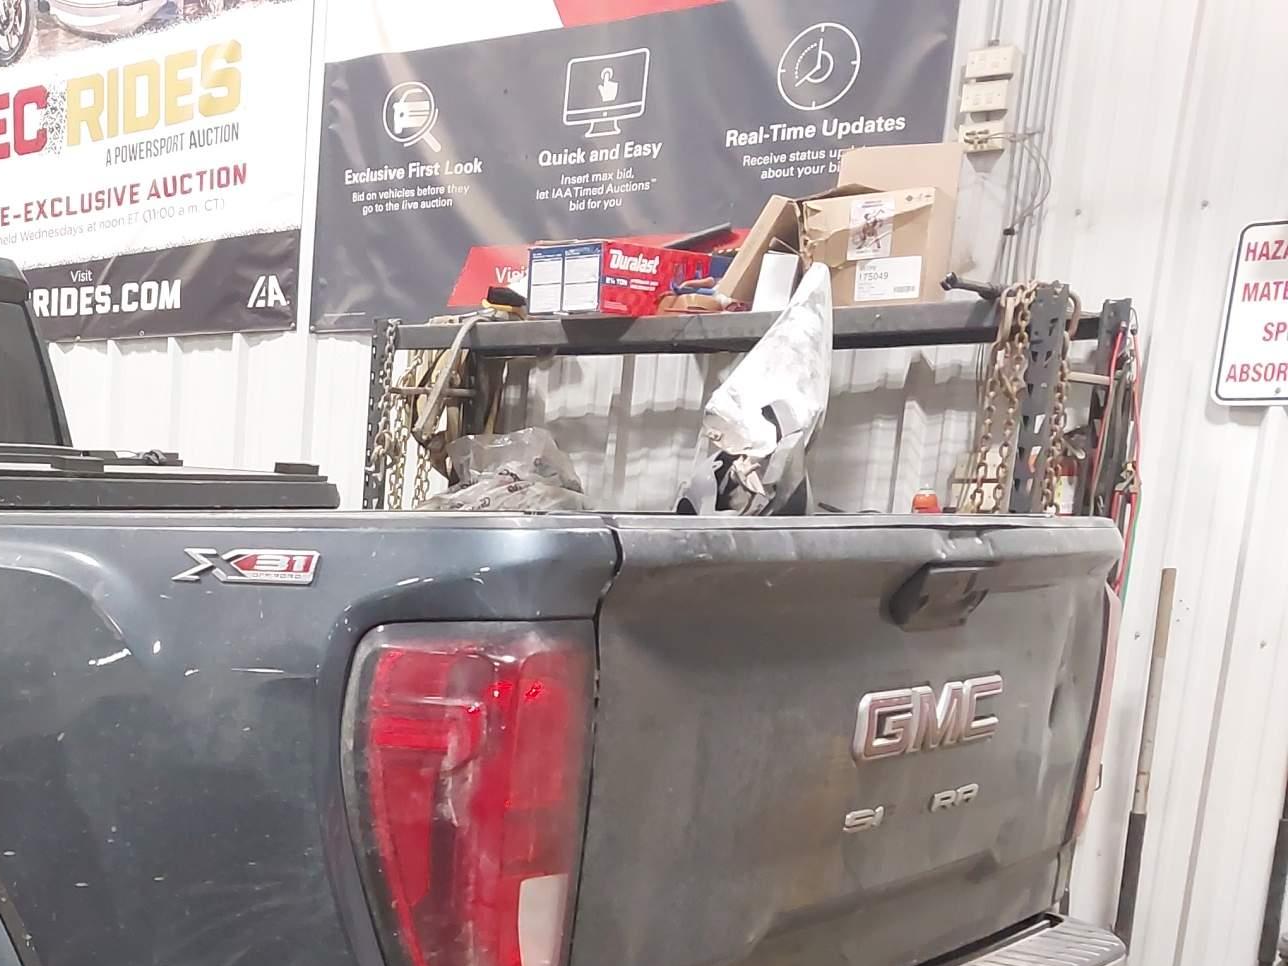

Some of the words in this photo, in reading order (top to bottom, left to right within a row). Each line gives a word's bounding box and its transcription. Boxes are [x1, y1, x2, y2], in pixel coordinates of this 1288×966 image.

[66, 39, 243, 147] RIDES
[105, 148, 112, 167] A
[115, 132, 185, 164] POWERSPORT
[189, 122, 240, 150] AUCTION
[725, 123, 816, 148] Real-Time
[822, 115, 906, 139] Updates
[538, 148, 585, 166] Quick
[590, 143, 620, 161] and
[623, 141, 663, 159] Easy
[743, 153, 786, 167] Receive
[789, 150, 825, 162] status
[146, 163, 247, 201] AUCTION
[344, 165, 405, 185] Exclusive
[408, 161, 440, 178] First
[444, 157, 484, 175] Look
[561, 173, 589, 185] Insert
[592, 172, 613, 183] max
[761, 166, 794, 179] about
[797, 164, 825, 178] your
[352, 192, 365, 203] Bid
[366, 192, 377, 201] on
[378, 188, 415, 199] vehicles
[417, 185, 445, 196] before
[447, 184, 470, 195] they
[536, 189, 549, 200] let
[552, 187, 572, 199] IAA
[573, 184, 604, 197] Timed
[569, 200, 585, 211] bid
[587, 199, 601, 209] for
[603, 197, 622, 210] you
[362, 204, 374, 216] go
[375, 203, 384, 212] to
[385, 200, 399, 211] the
[402, 198, 419, 209] live
[420, 197, 453, 208] auction
[20, 224, 84, 241] Wednesdays
[87, 221, 97, 233] at
[99, 217, 125, 230] noon
[128, 212, 140, 225] ET
[609, 248, 660, 275] Duralast
[70, 270, 93, 282] Visit
[28, 279, 181, 317] RIDES.COM
[852, 673, 1004, 762] GMC
